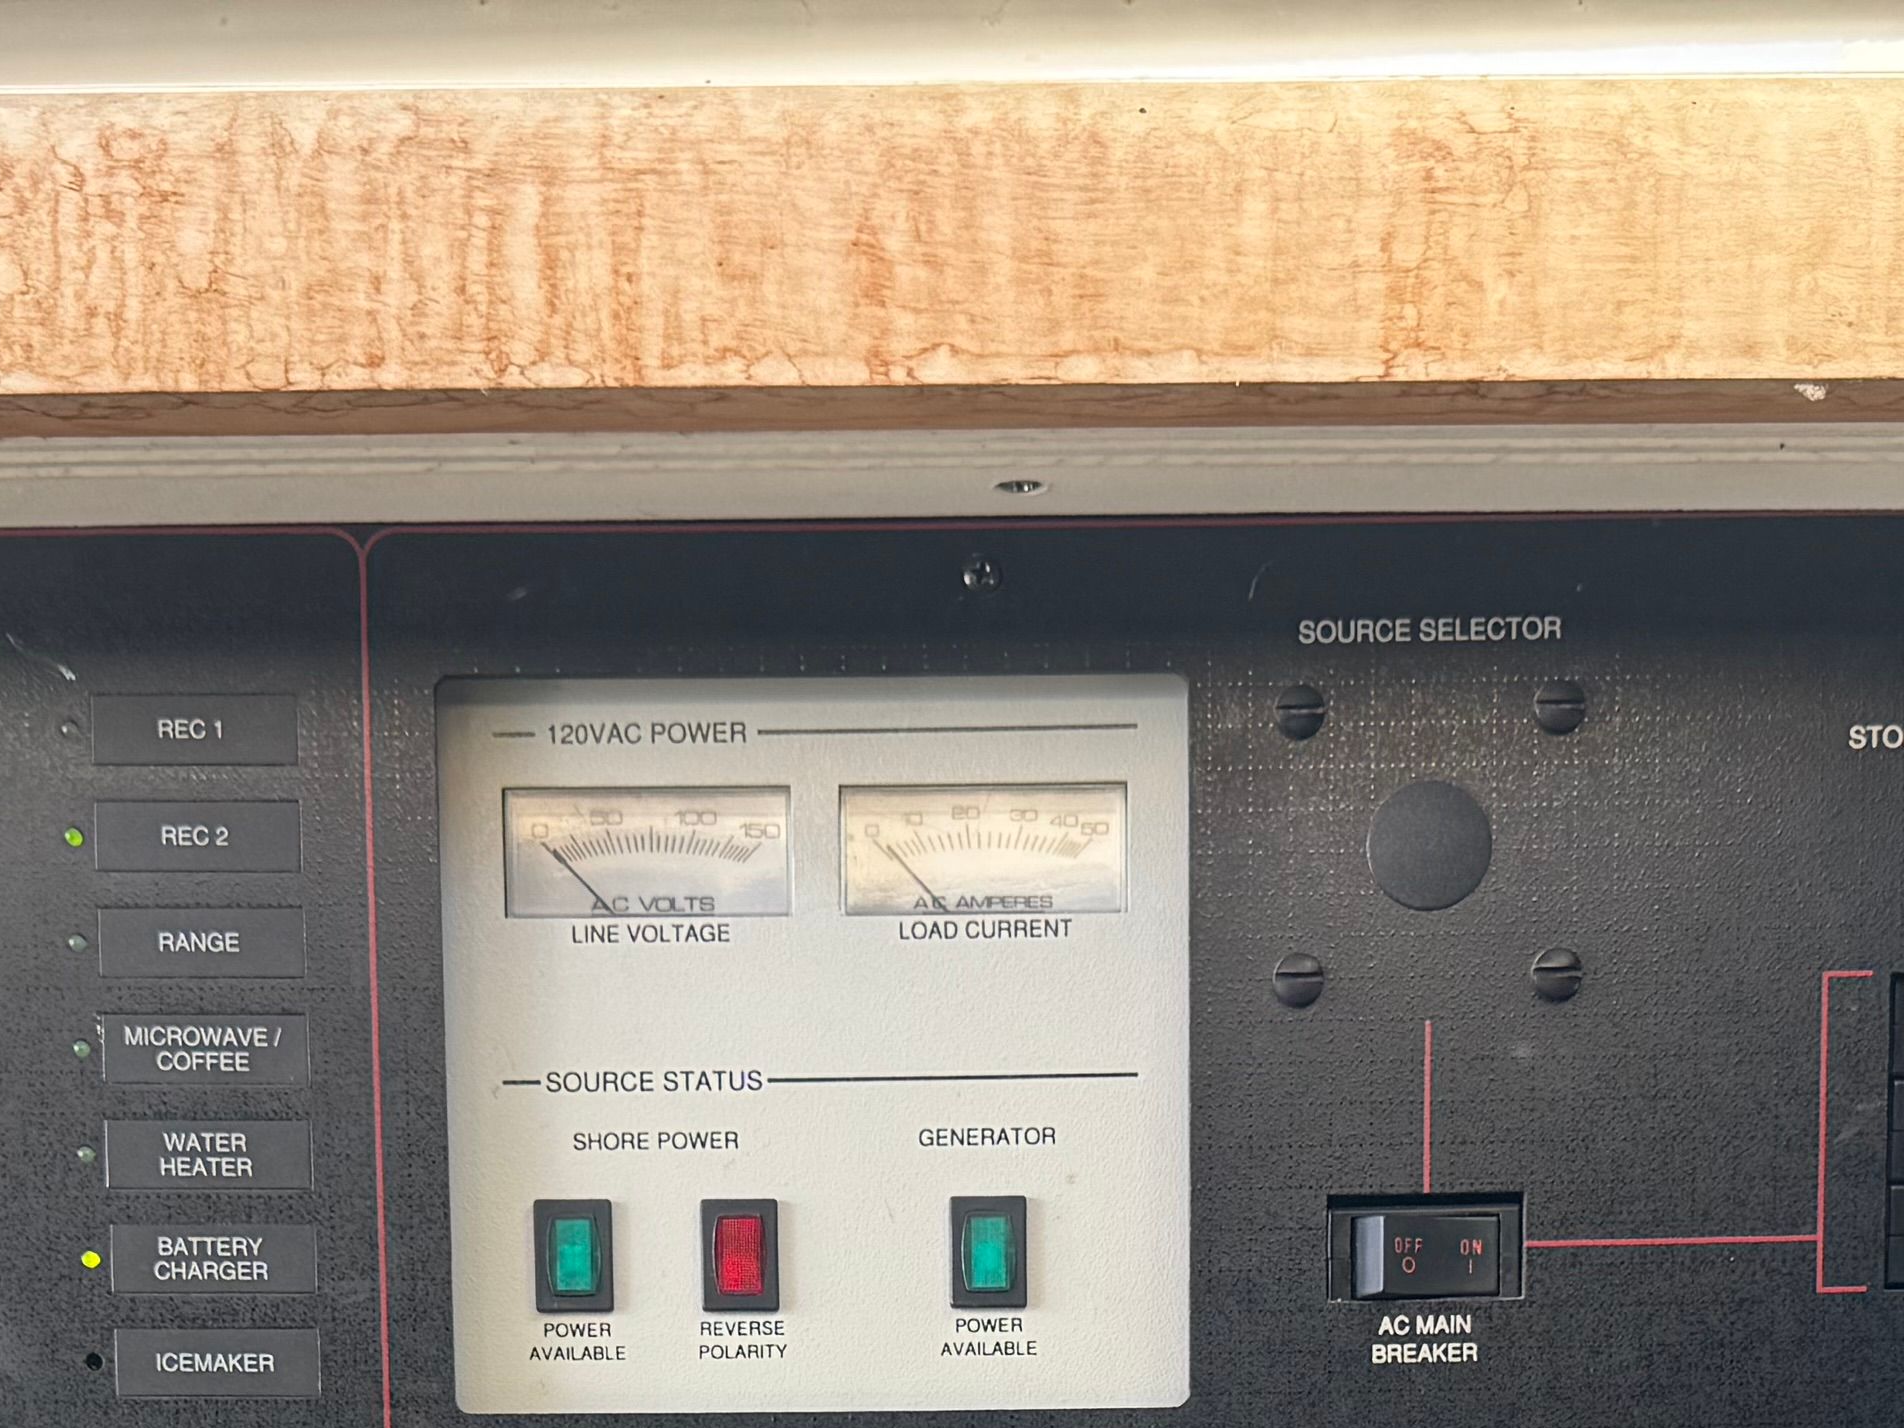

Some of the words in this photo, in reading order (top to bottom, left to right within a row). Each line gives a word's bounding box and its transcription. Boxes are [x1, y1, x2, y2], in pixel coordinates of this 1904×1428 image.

[1298, 618, 1412, 644] SOURCE
[1419, 616, 1562, 642] SELECTOR
[548, 722, 642, 745] 120VAC
[651, 721, 747, 745] POWER
[161, 825, 210, 846] REC
[215, 826, 229, 846] 2
[638, 896, 715, 913] VOLTS
[899, 920, 958, 940] LOAD
[965, 918, 1073, 940] CURRENT
[162, 1132, 247, 1153] WATER
[918, 1126, 1056, 1147] GENERATOR
[159, 1156, 253, 1177] HEATER
[955, 1317, 1023, 1333] POWER
[940, 1340, 1037, 1357] AVAILABLE
[156, 1352, 275, 1373] ICEMAKER
